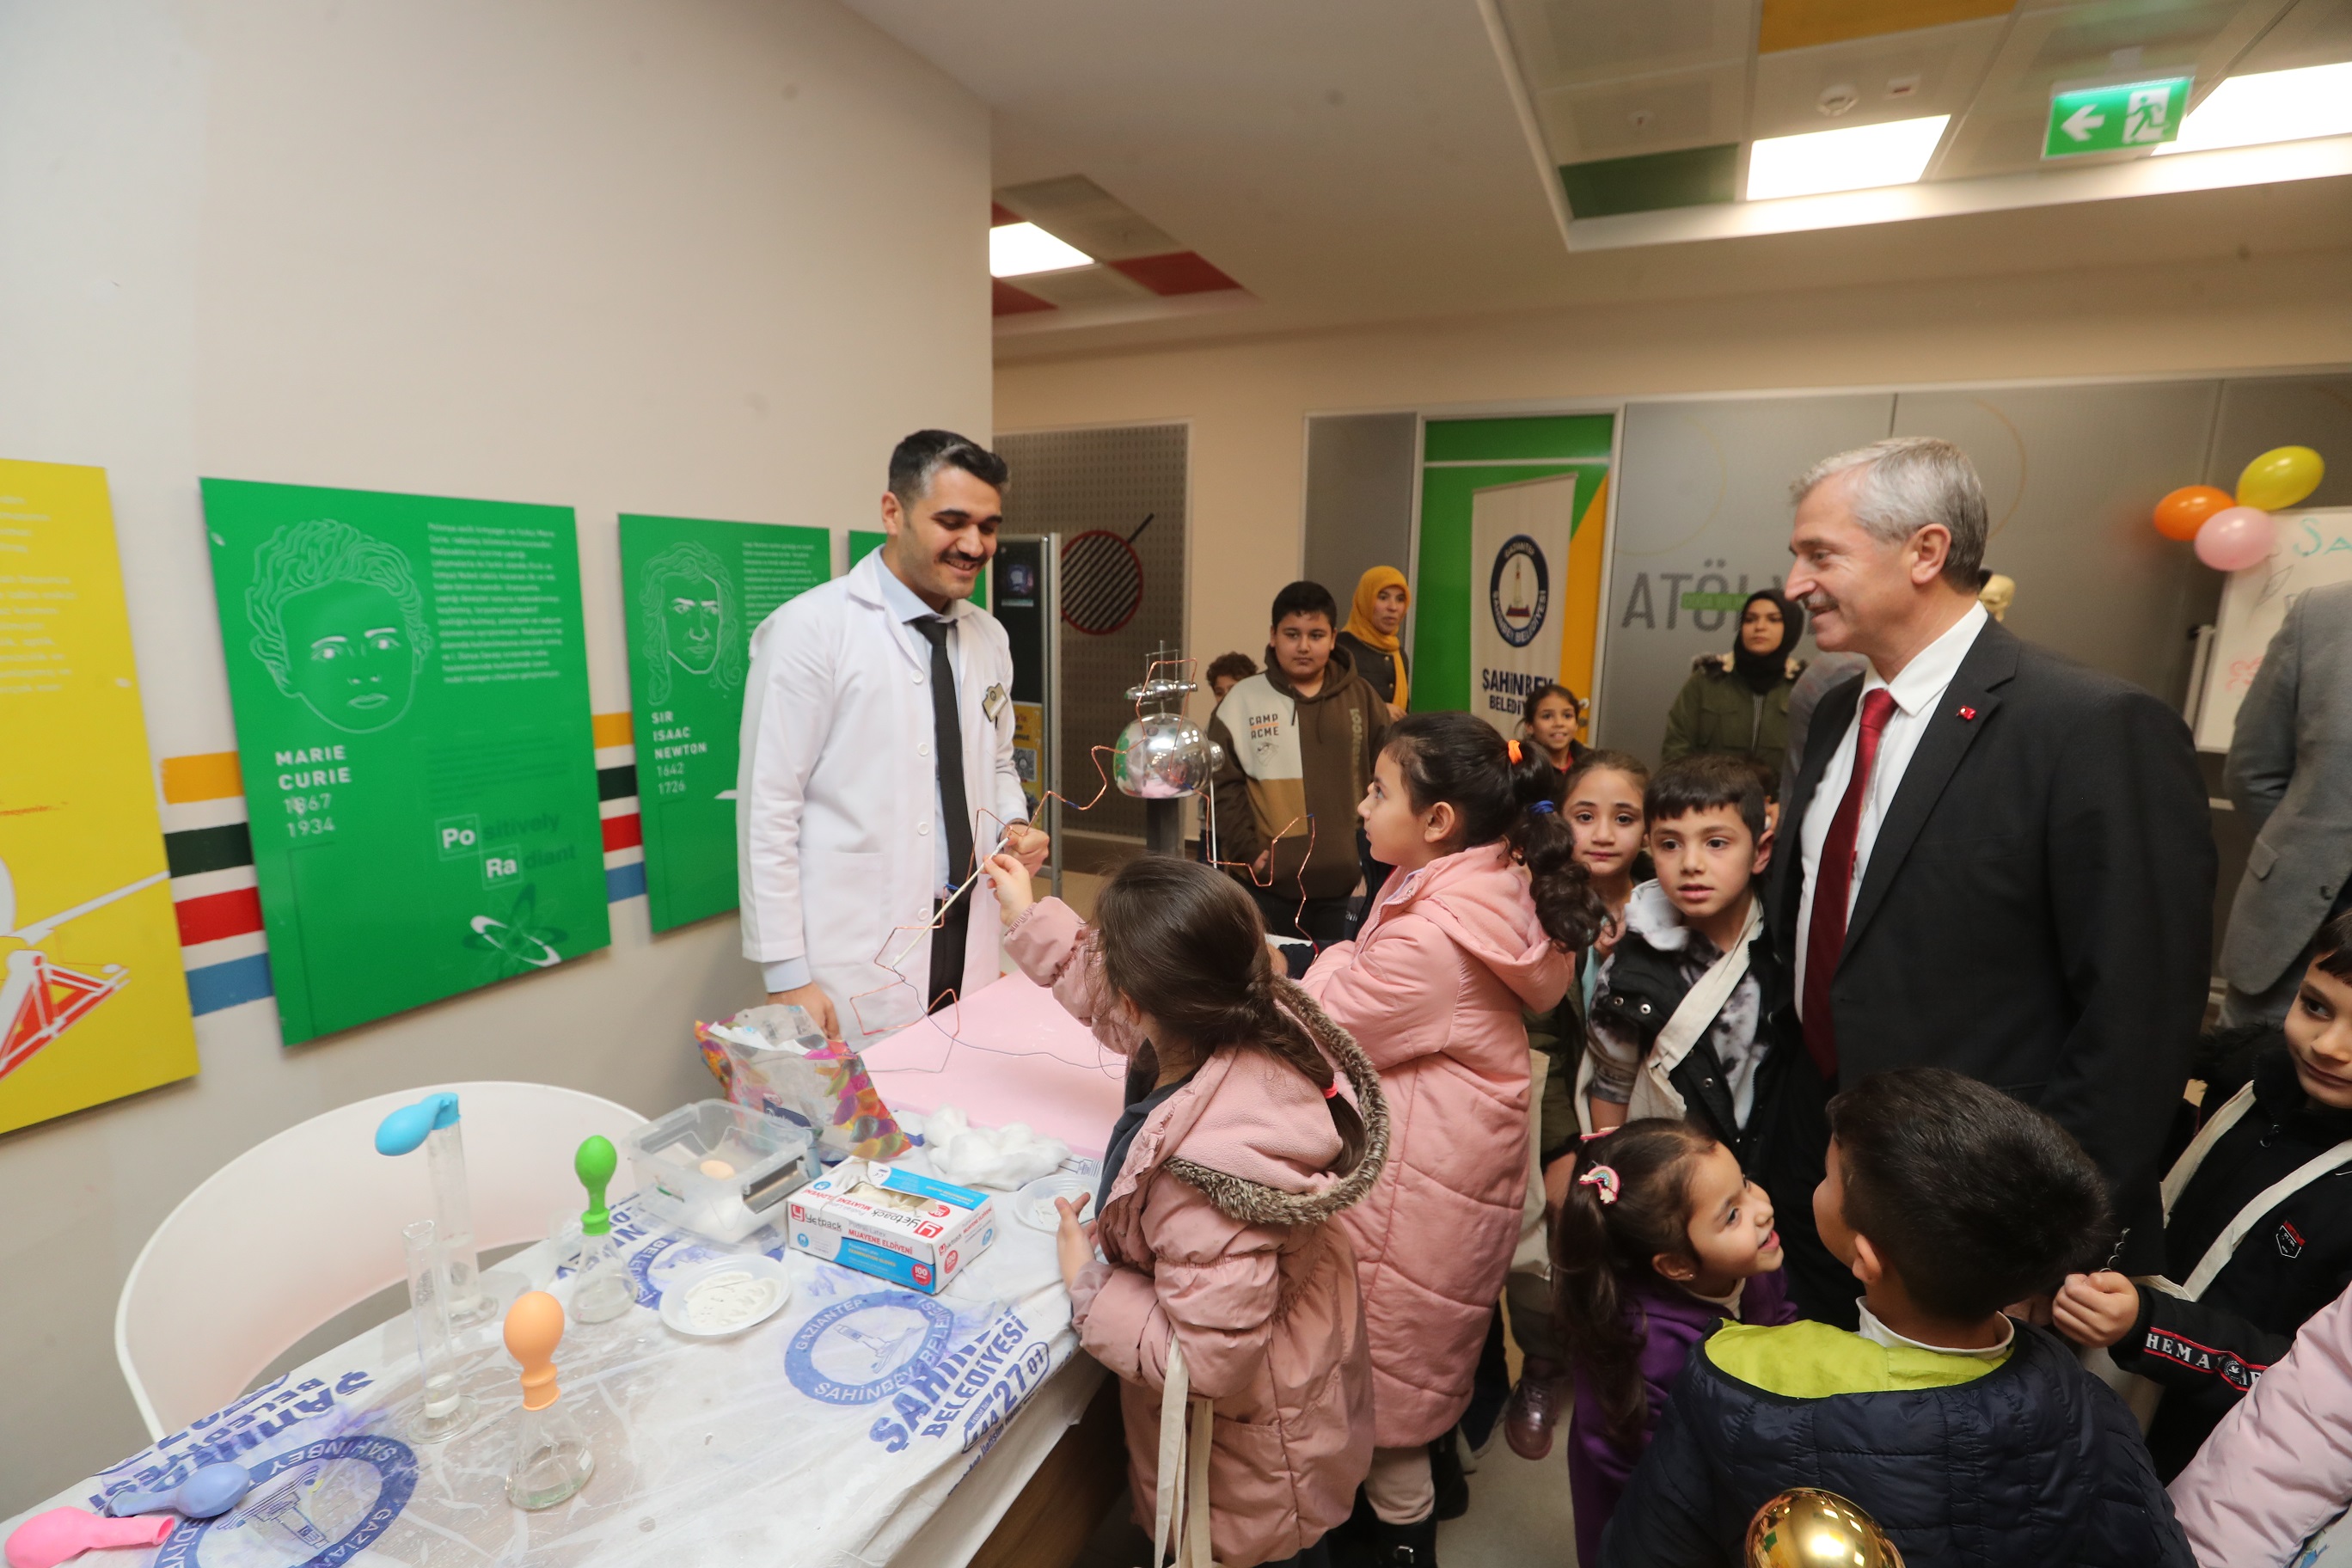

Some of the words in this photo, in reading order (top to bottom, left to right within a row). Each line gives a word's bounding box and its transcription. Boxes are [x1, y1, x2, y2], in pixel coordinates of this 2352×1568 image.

[651, 710, 674, 726] SIR
[1248, 713, 1279, 726] CAMP
[652, 726, 692, 743] ISAAC
[1250, 726, 1280, 740] ACME
[274, 744, 347, 767] MARIE
[654, 741, 707, 761] NEWTON
[278, 767, 353, 791] CURIE
[657, 761, 685, 779] 1642
[658, 779, 686, 796] 1726
[286, 816, 337, 838] 1934
[441, 827, 477, 849] Po
[485, 857, 518, 879] Ra
[848, 1228, 881, 1246] MUAYENE
[881, 1238, 914, 1256] ELDİVENİ
[921, 1314, 1030, 1440] BELEDİYESİ
